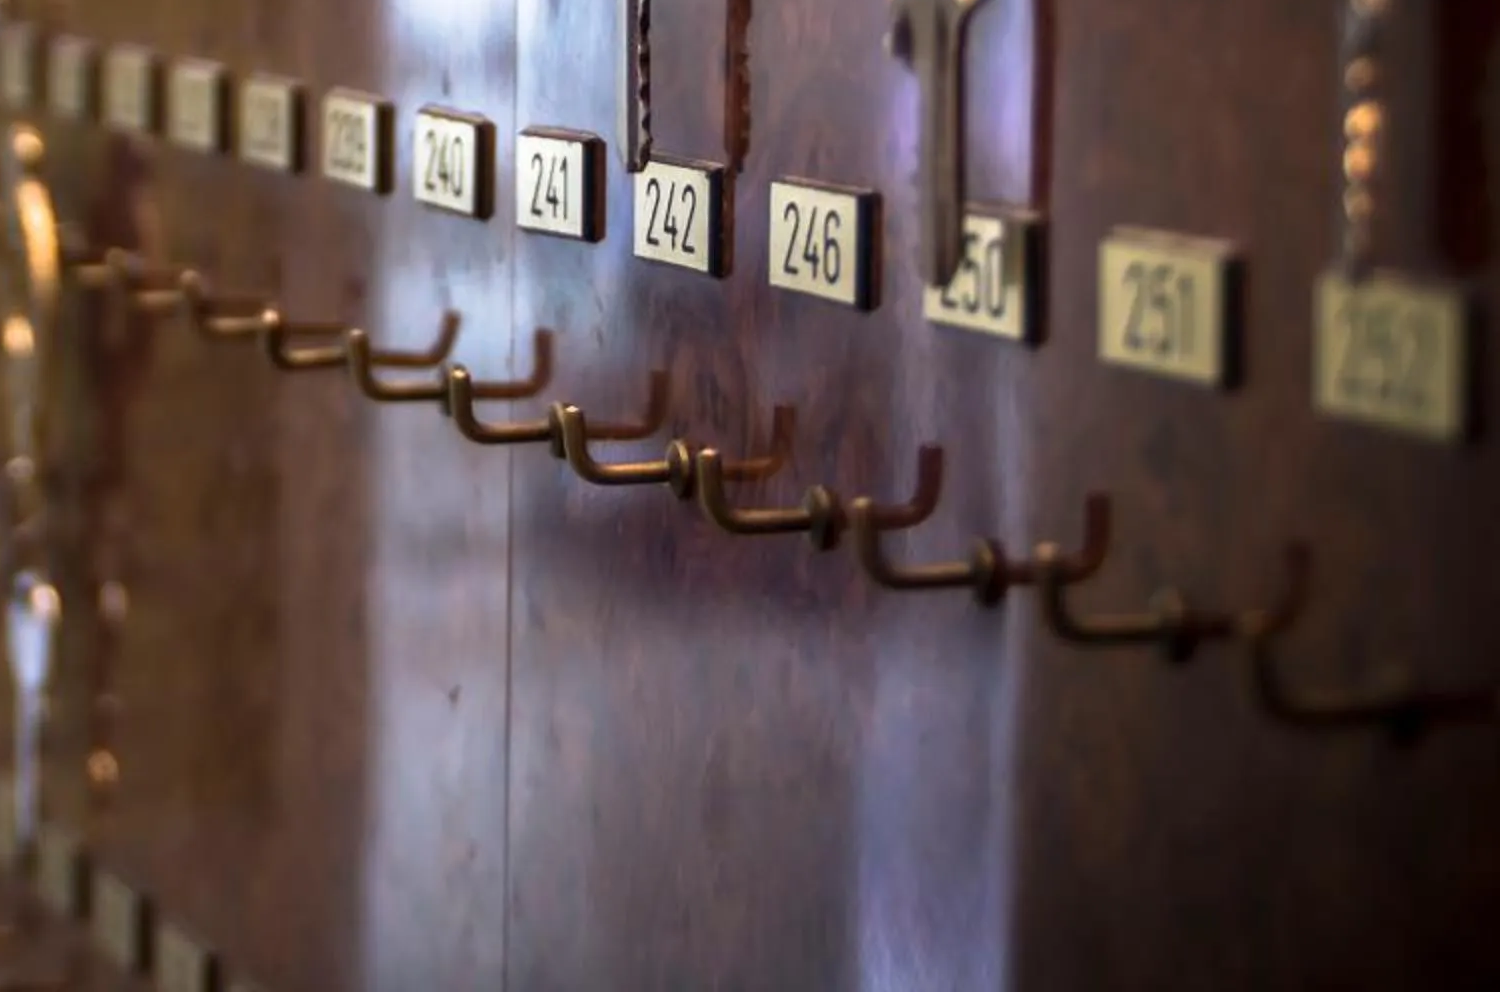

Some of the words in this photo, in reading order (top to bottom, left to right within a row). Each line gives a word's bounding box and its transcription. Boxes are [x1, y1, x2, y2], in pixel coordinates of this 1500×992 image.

[424, 127, 464, 198] 240
[530, 151, 569, 221] 241
[646, 177, 697, 254] 242
[783, 201, 841, 285] 246
[1122, 259, 1197, 358] 251
